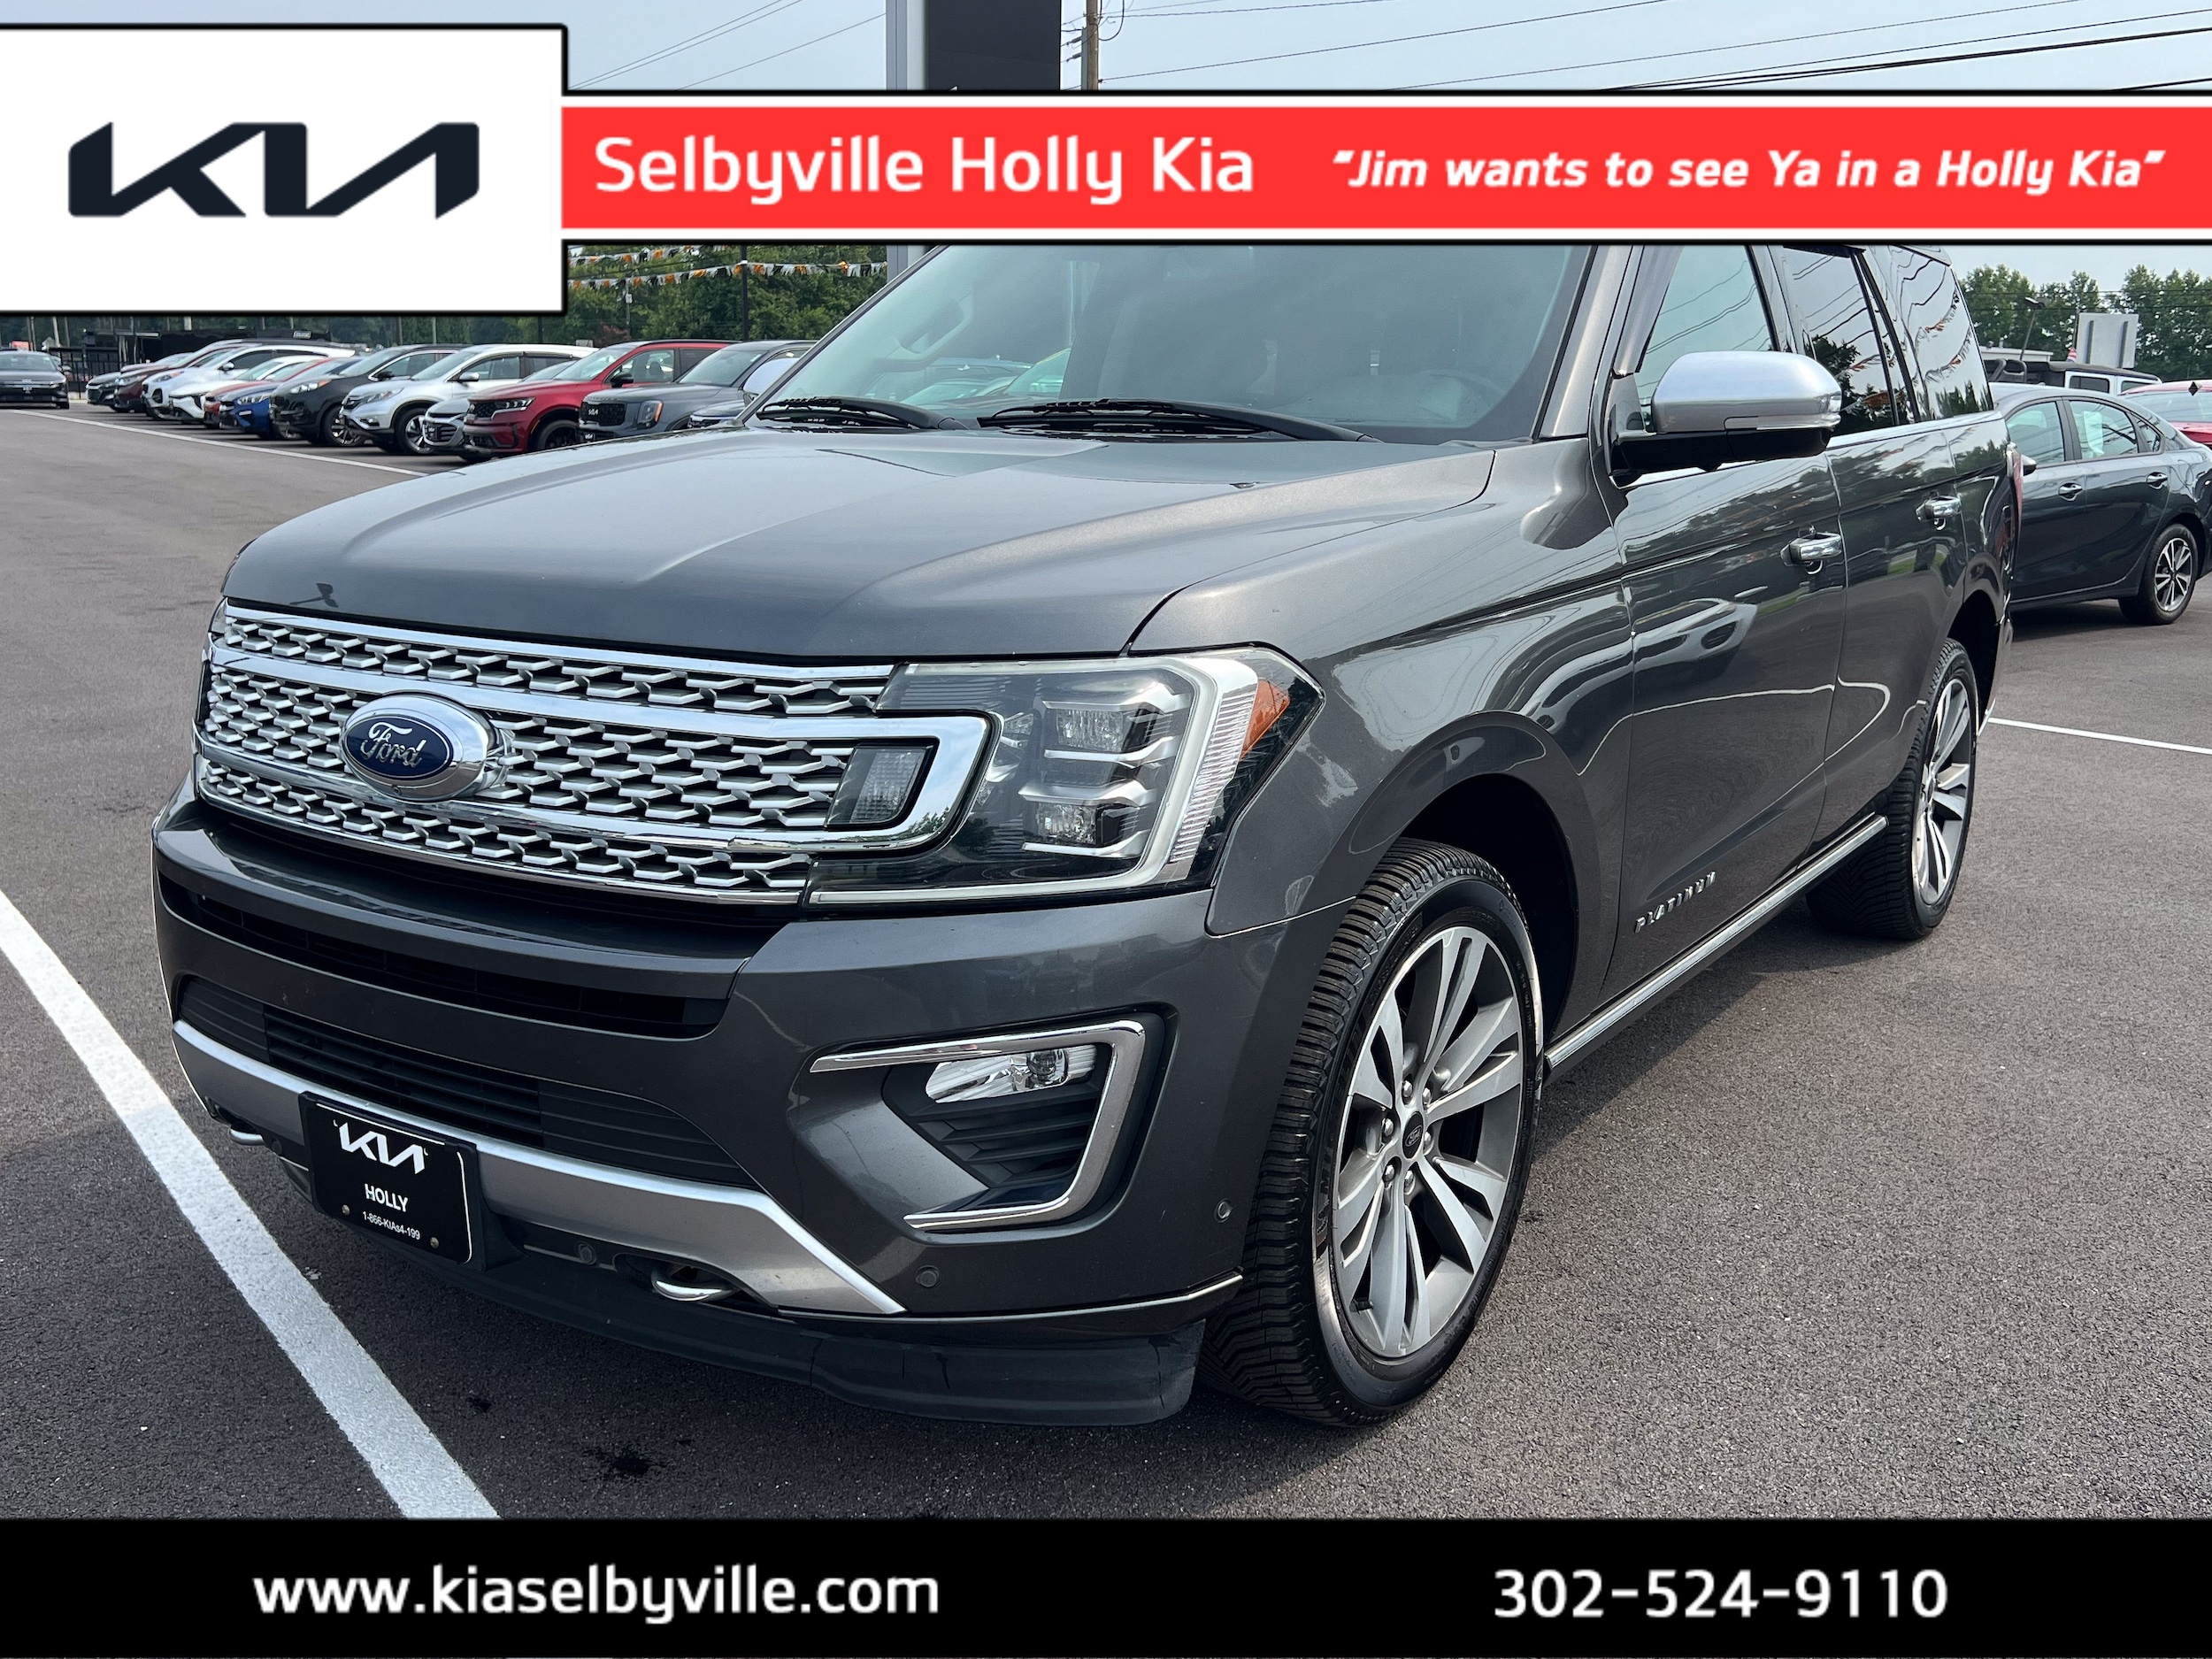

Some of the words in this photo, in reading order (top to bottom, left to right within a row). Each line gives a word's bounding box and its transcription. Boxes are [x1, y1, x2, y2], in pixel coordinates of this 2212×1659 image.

[360, 721, 427, 768] Ford
[1635, 871, 1716, 933] PLATINUM
[338, 1121, 426, 1175] KIA
[364, 1183, 409, 1212] HOLLY
